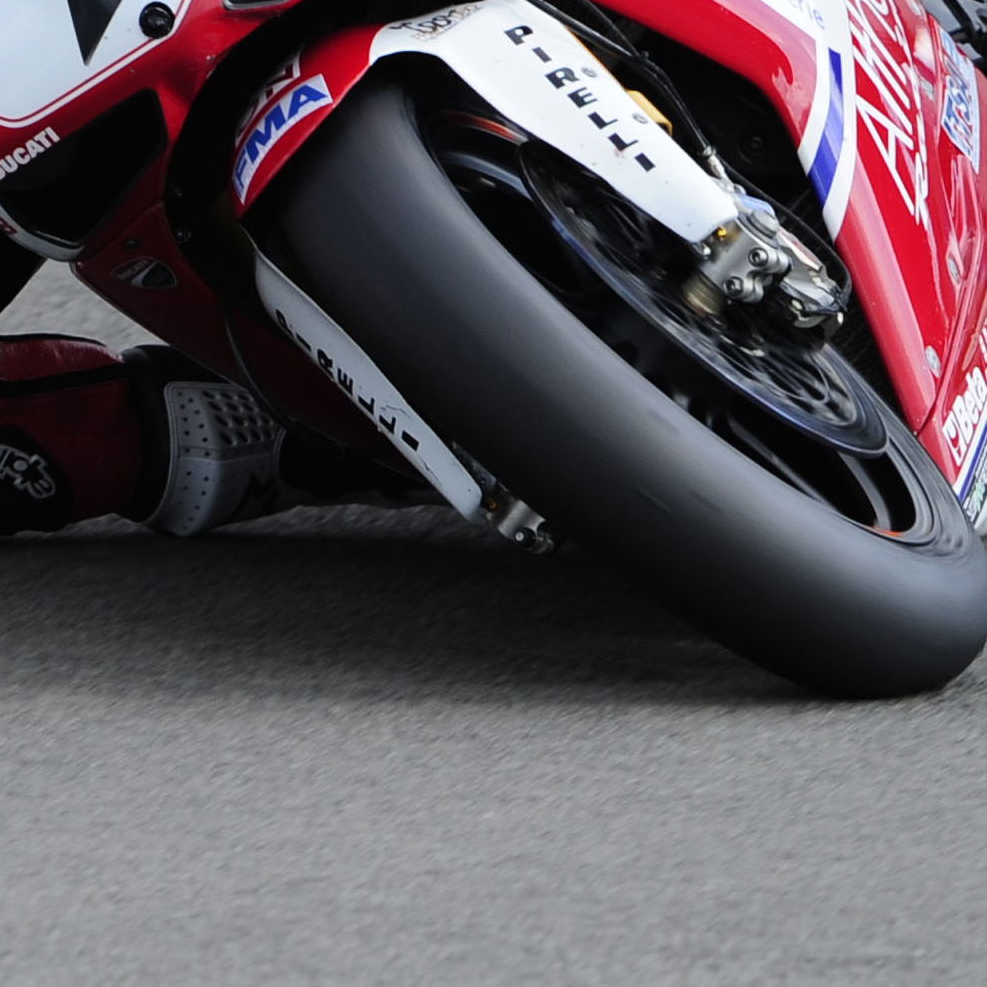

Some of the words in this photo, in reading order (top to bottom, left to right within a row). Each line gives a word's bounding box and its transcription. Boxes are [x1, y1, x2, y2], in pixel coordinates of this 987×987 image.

[233, 84, 329, 195] FMA
[503, 25, 656, 173] PIRELLI
[275, 309, 420, 452] PIRELLI
